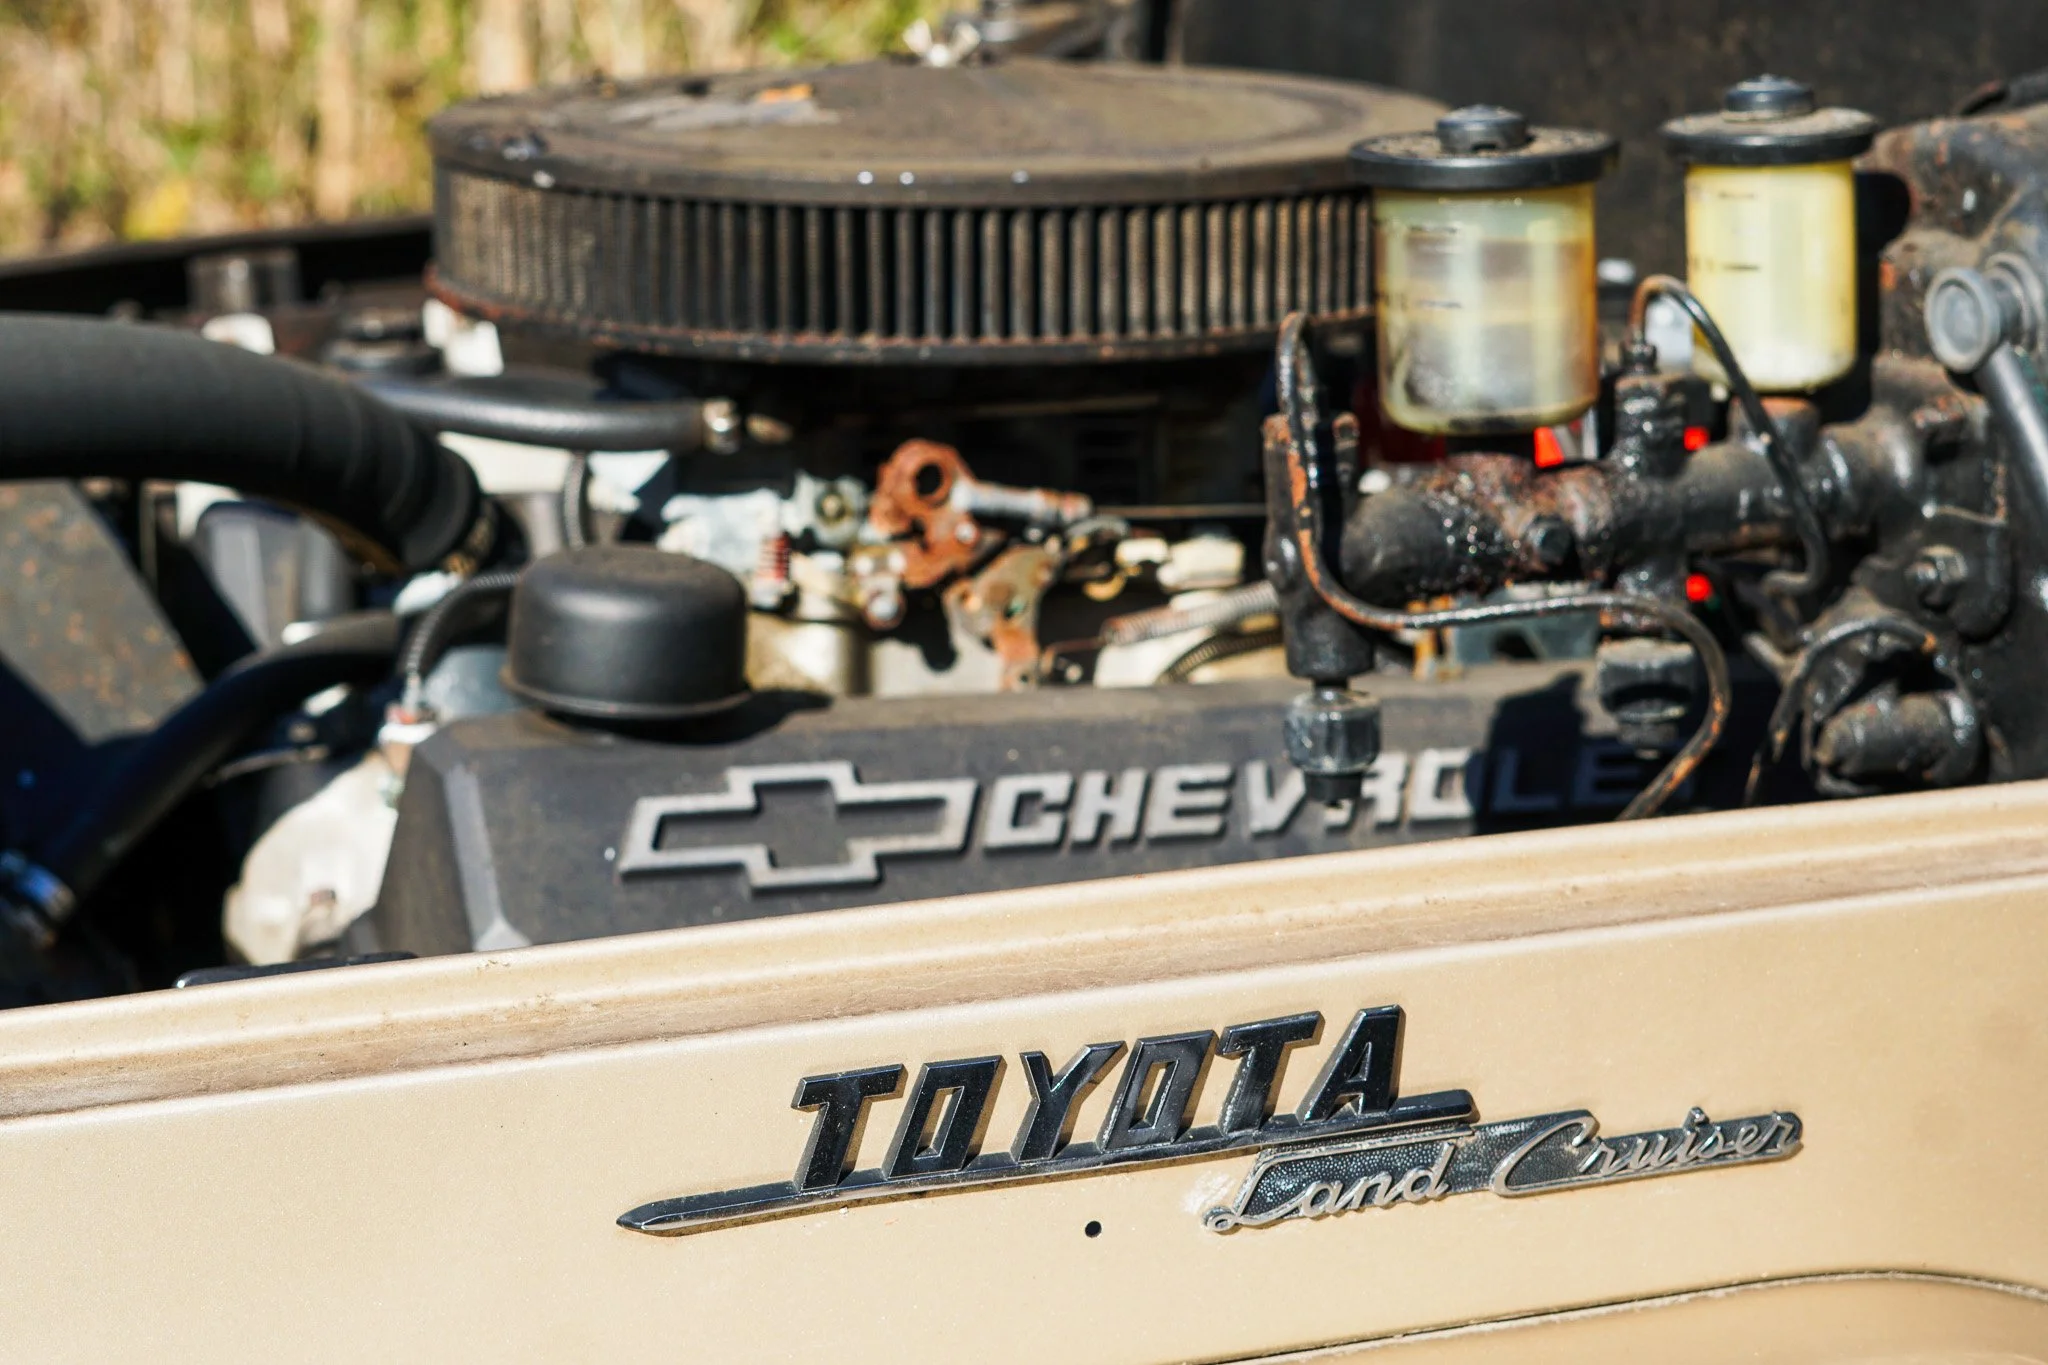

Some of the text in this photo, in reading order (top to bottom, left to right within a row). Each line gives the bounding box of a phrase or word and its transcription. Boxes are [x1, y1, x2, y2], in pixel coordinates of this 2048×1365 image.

[791, 1005, 1405, 1191] TOYOTA
[1202, 1106, 1800, 1234] Land Cruiser
